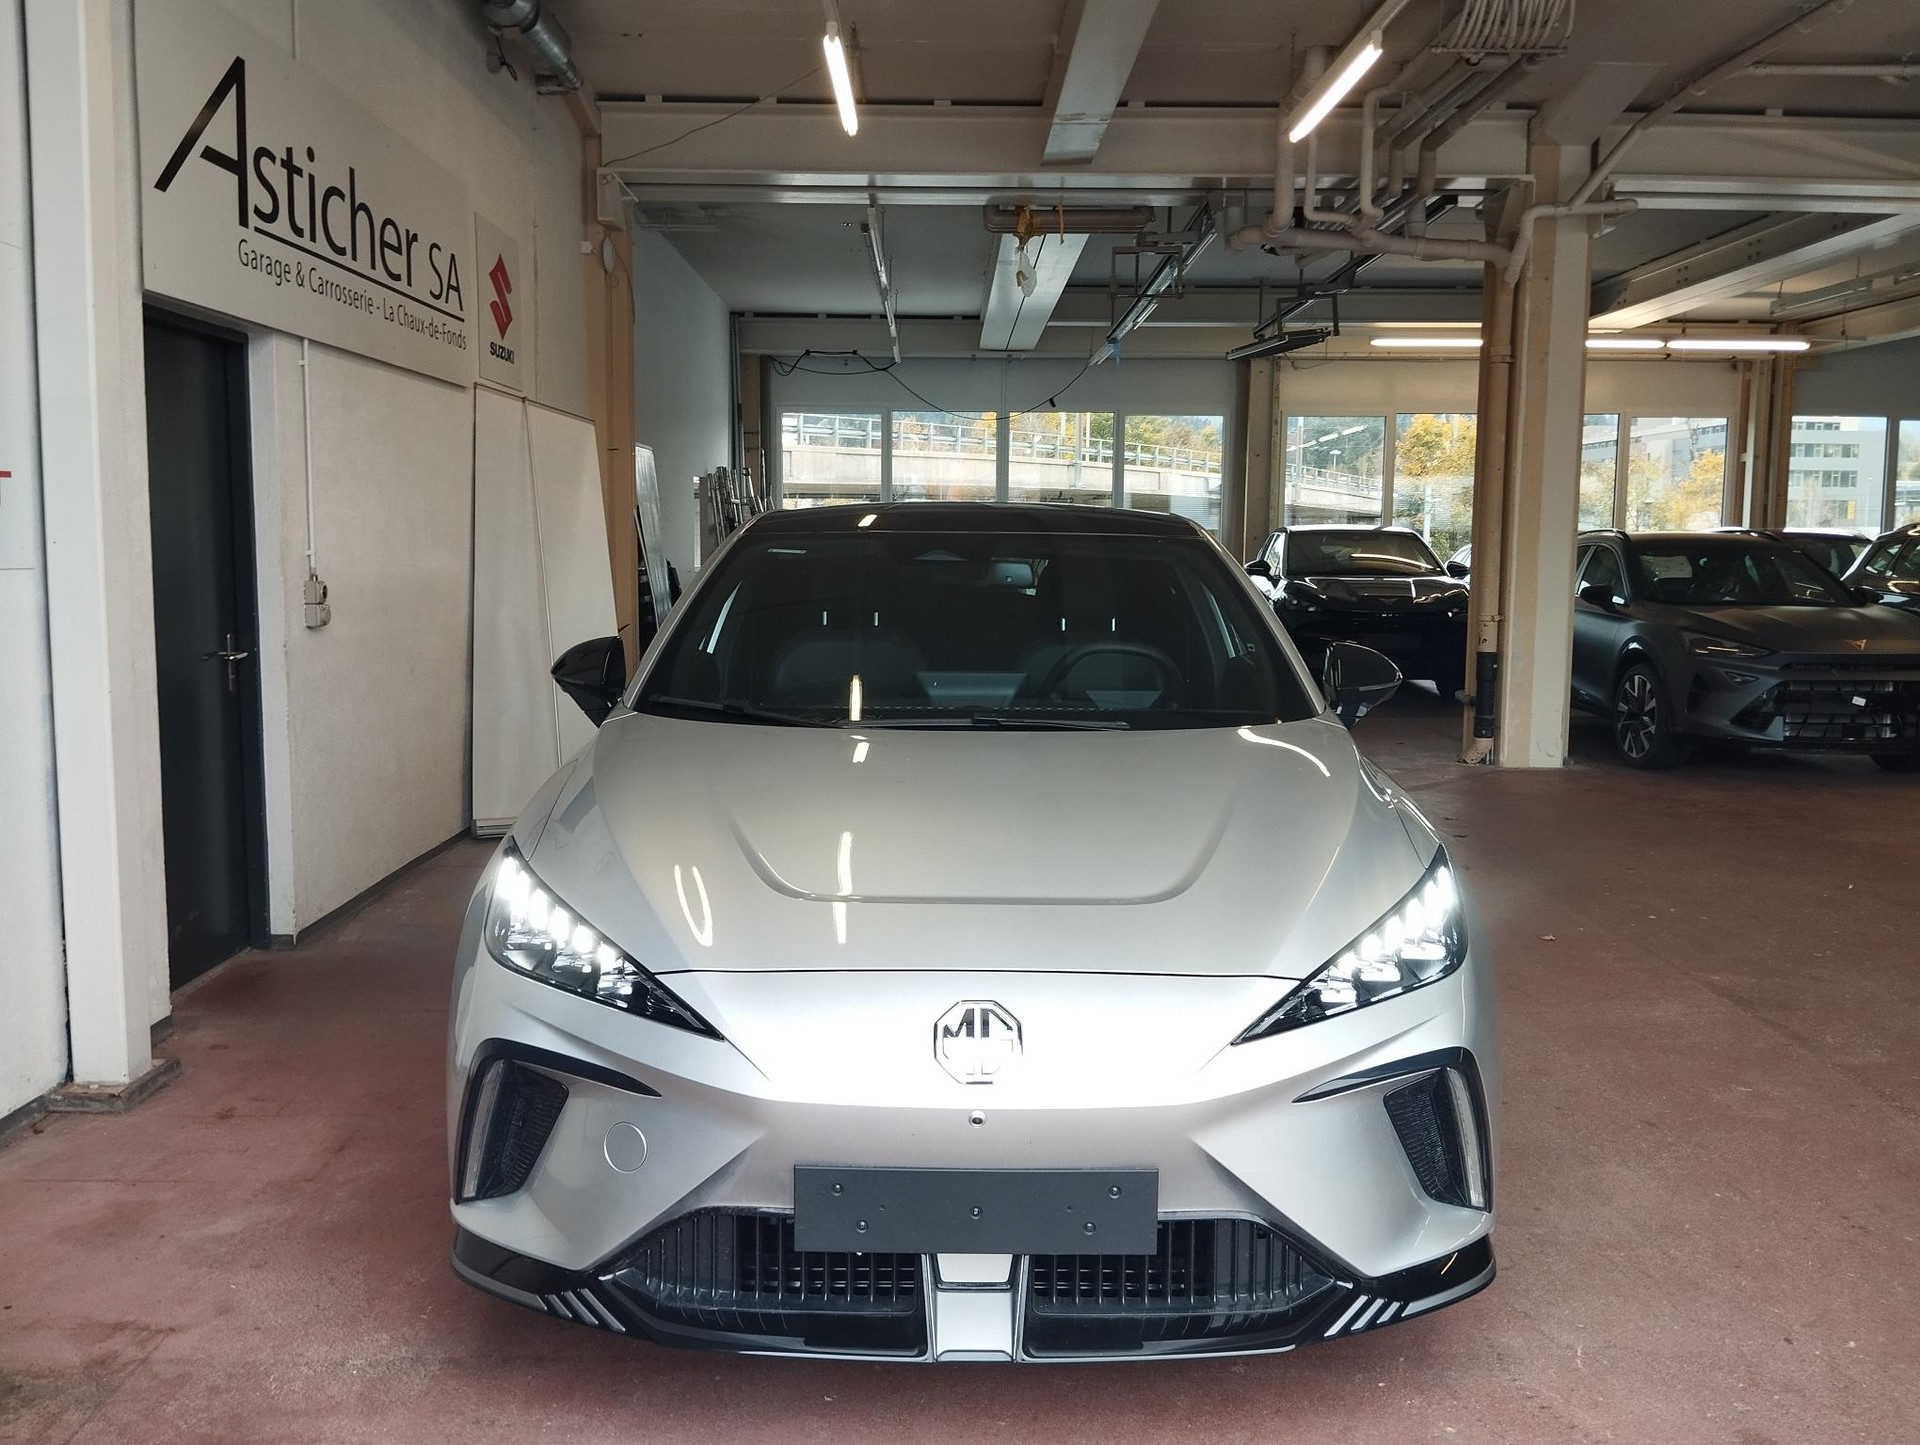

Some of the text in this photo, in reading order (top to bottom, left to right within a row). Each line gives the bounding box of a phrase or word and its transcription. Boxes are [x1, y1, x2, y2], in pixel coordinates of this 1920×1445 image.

[154, 56, 464, 312] Asticher SA
[238, 238, 292, 287] Garage
[295, 260, 305, 289] &
[309, 266, 374, 315] Carrosserie
[383, 297, 395, 323] La
[397, 304, 467, 351] Chaux-de-Fonds
[489, 340, 515, 365] SUZUKI
